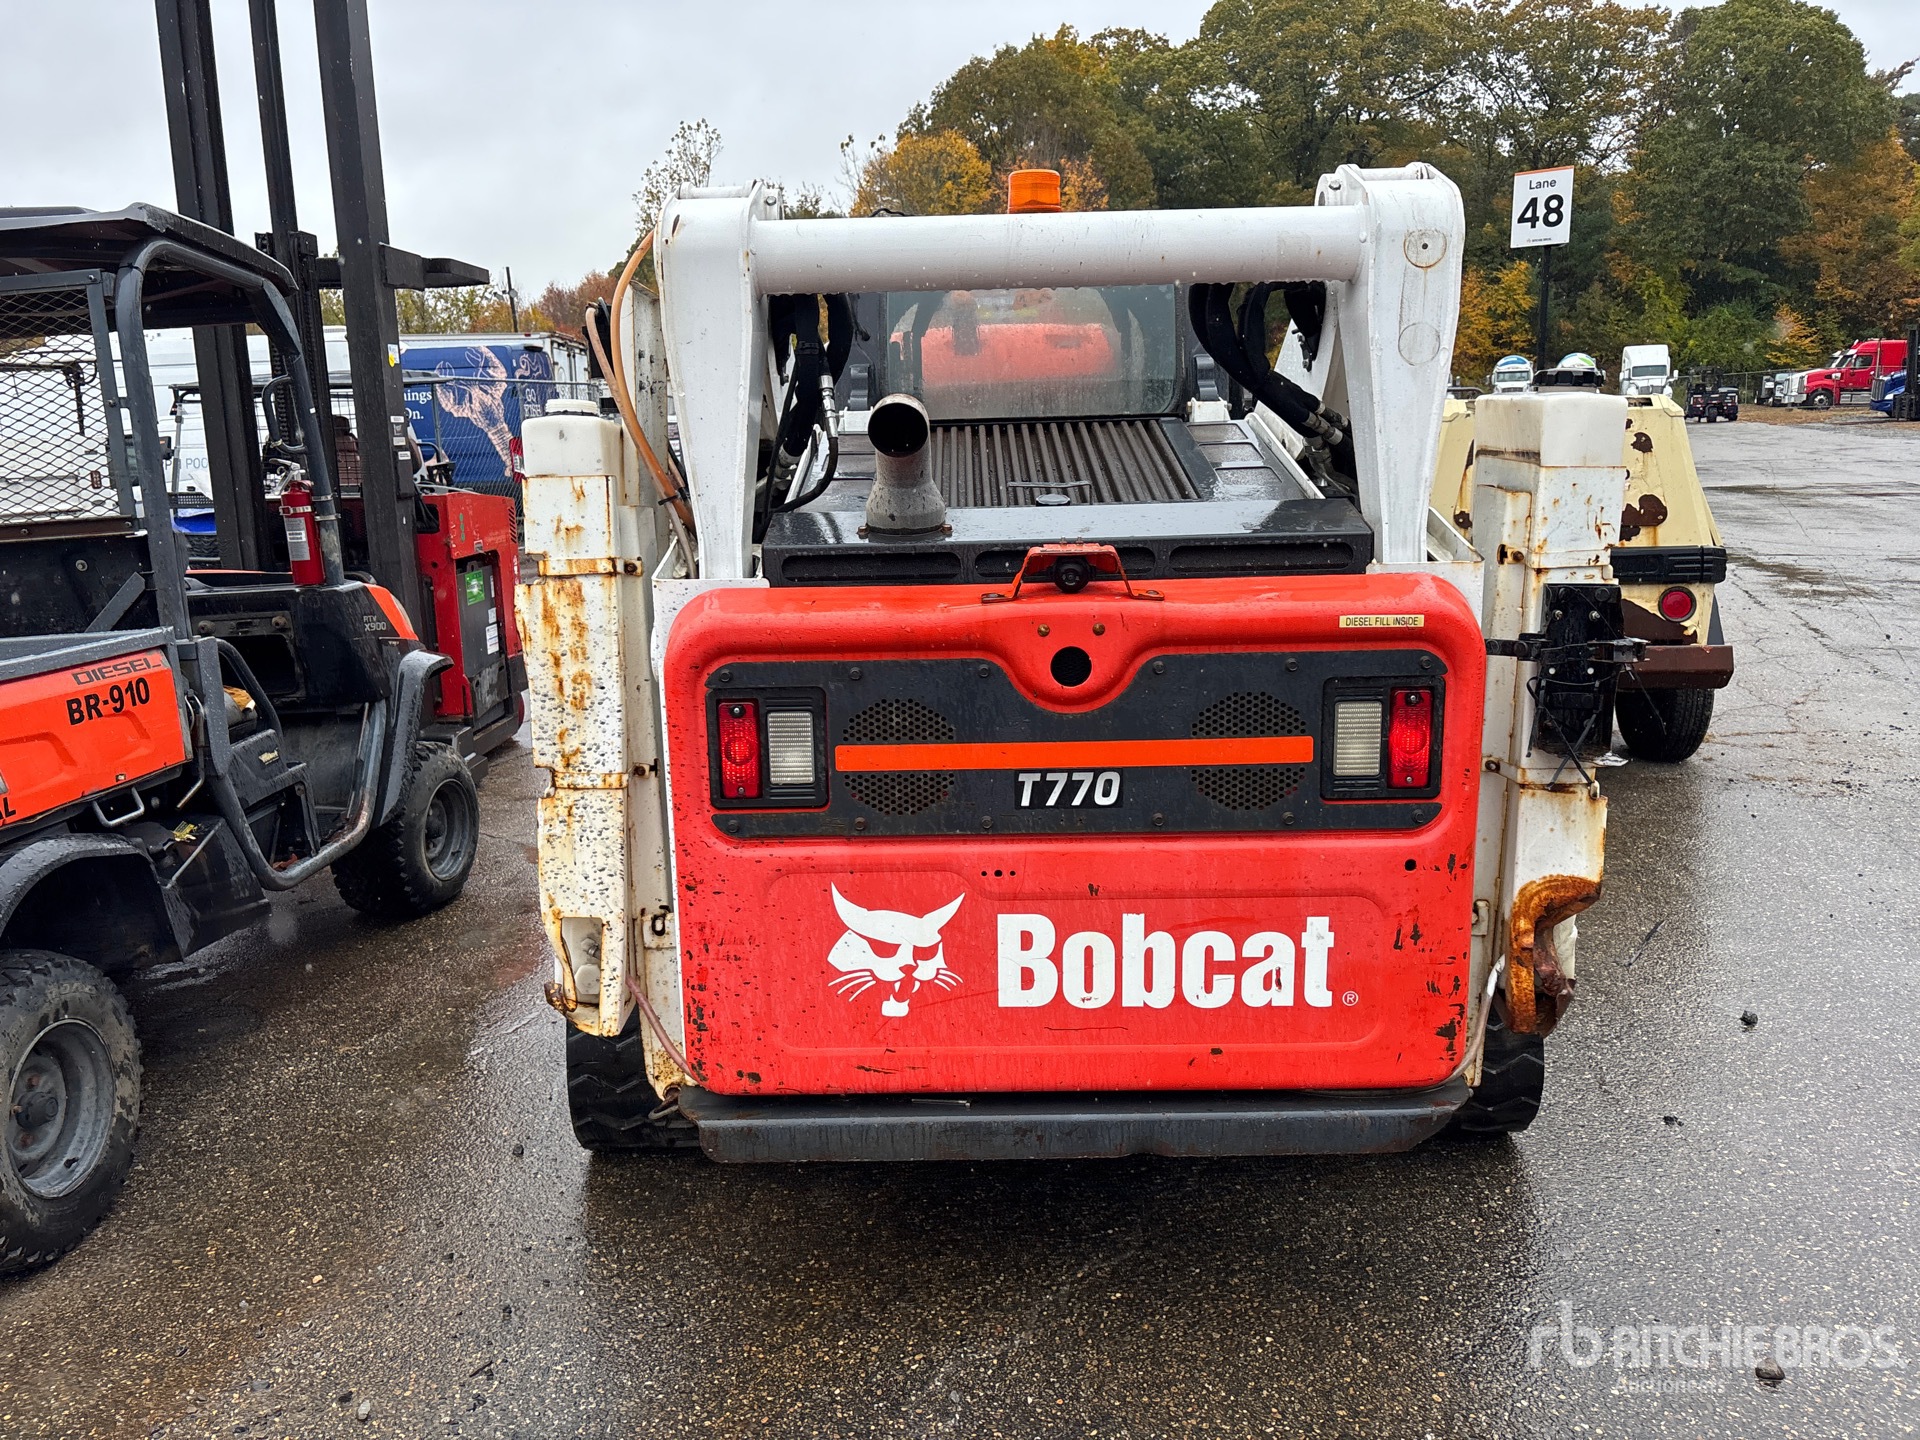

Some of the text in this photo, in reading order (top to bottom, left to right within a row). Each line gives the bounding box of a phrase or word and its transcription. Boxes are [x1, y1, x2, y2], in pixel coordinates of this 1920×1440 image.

[1529, 179, 1557, 190] Lane
[1517, 193, 1564, 229] 48
[363, 615, 377, 623] RTV
[364, 621, 387, 632] X900
[1345, 616, 1419, 627] DIESEL FILL INSIDE
[72, 657, 162, 686] DIESEL
[66, 677, 150, 726] BR-910
[1018, 771, 1121, 807] T770
[997, 913, 1335, 1009] Bobcat
